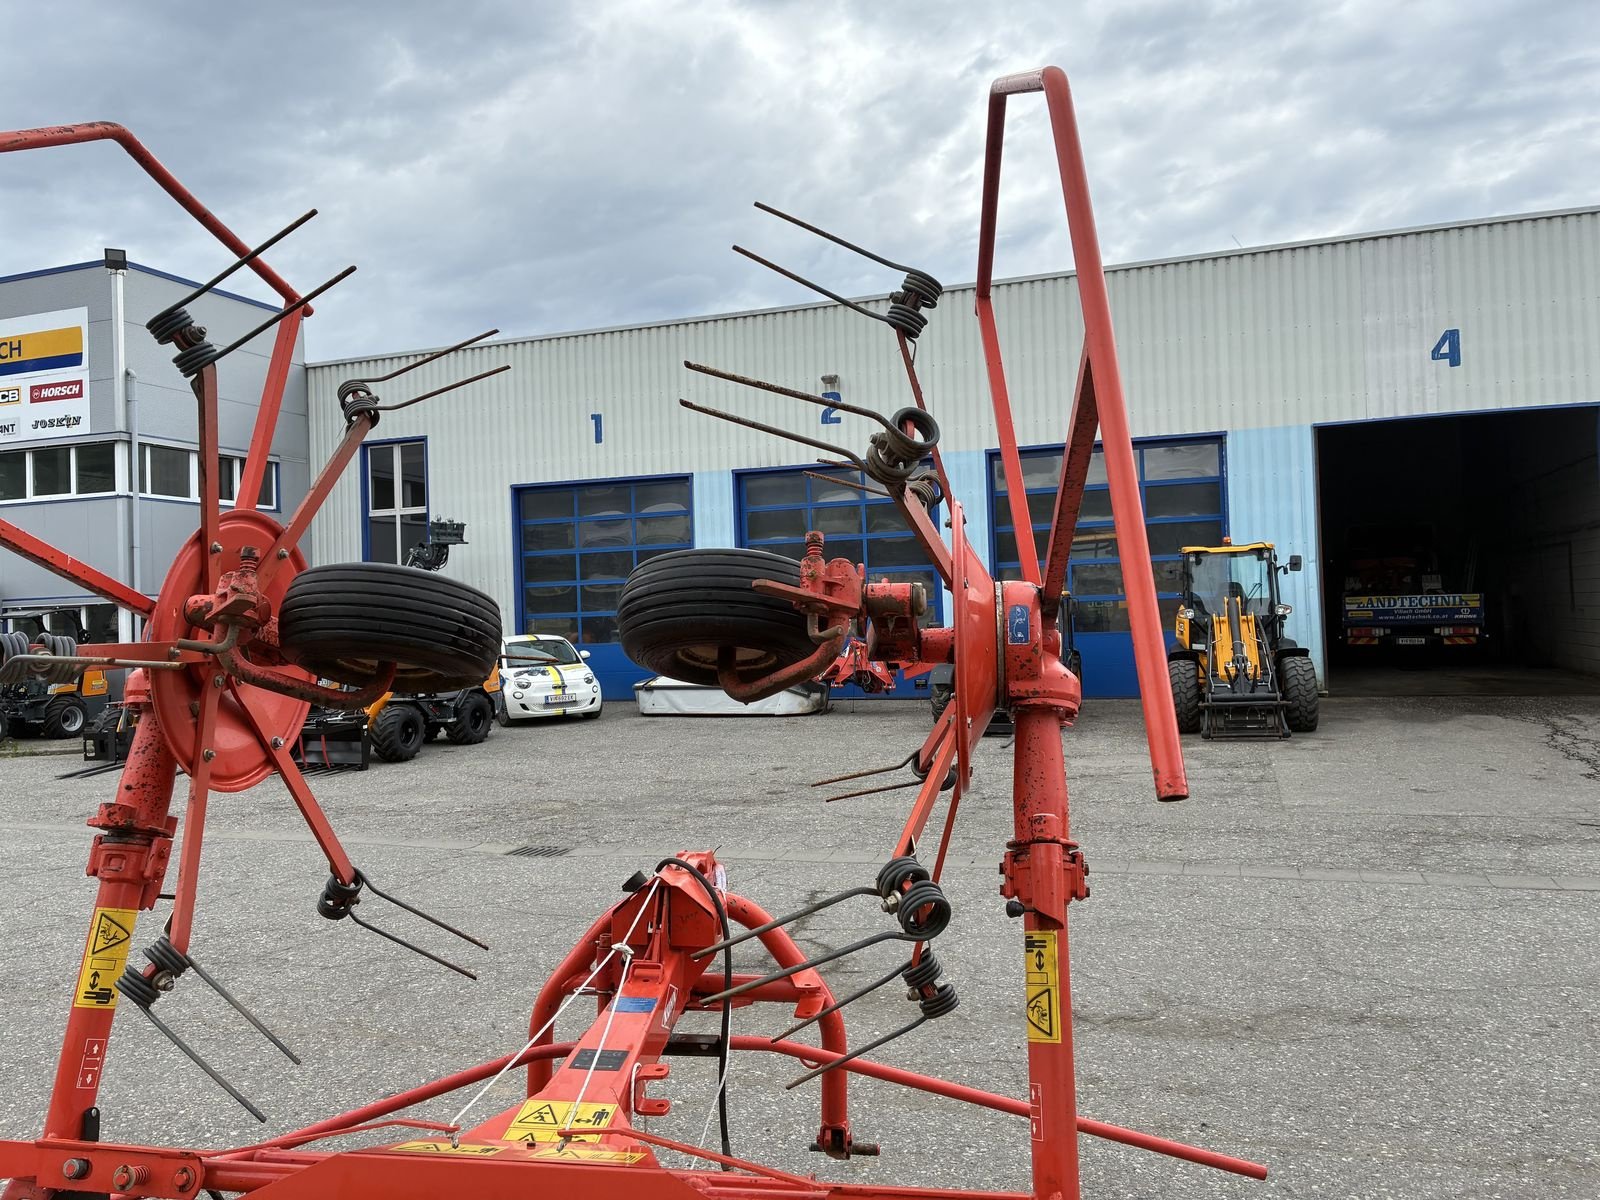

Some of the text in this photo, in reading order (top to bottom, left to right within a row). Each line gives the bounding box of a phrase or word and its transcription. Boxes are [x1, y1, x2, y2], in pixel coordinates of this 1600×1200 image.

[1431, 328, 1461, 367] 4
[41, 384, 80, 398] HORSCH
[32, 415, 81, 429] JOSKIN
[820, 392, 841, 424] 2
[590, 413, 602, 444] 1
